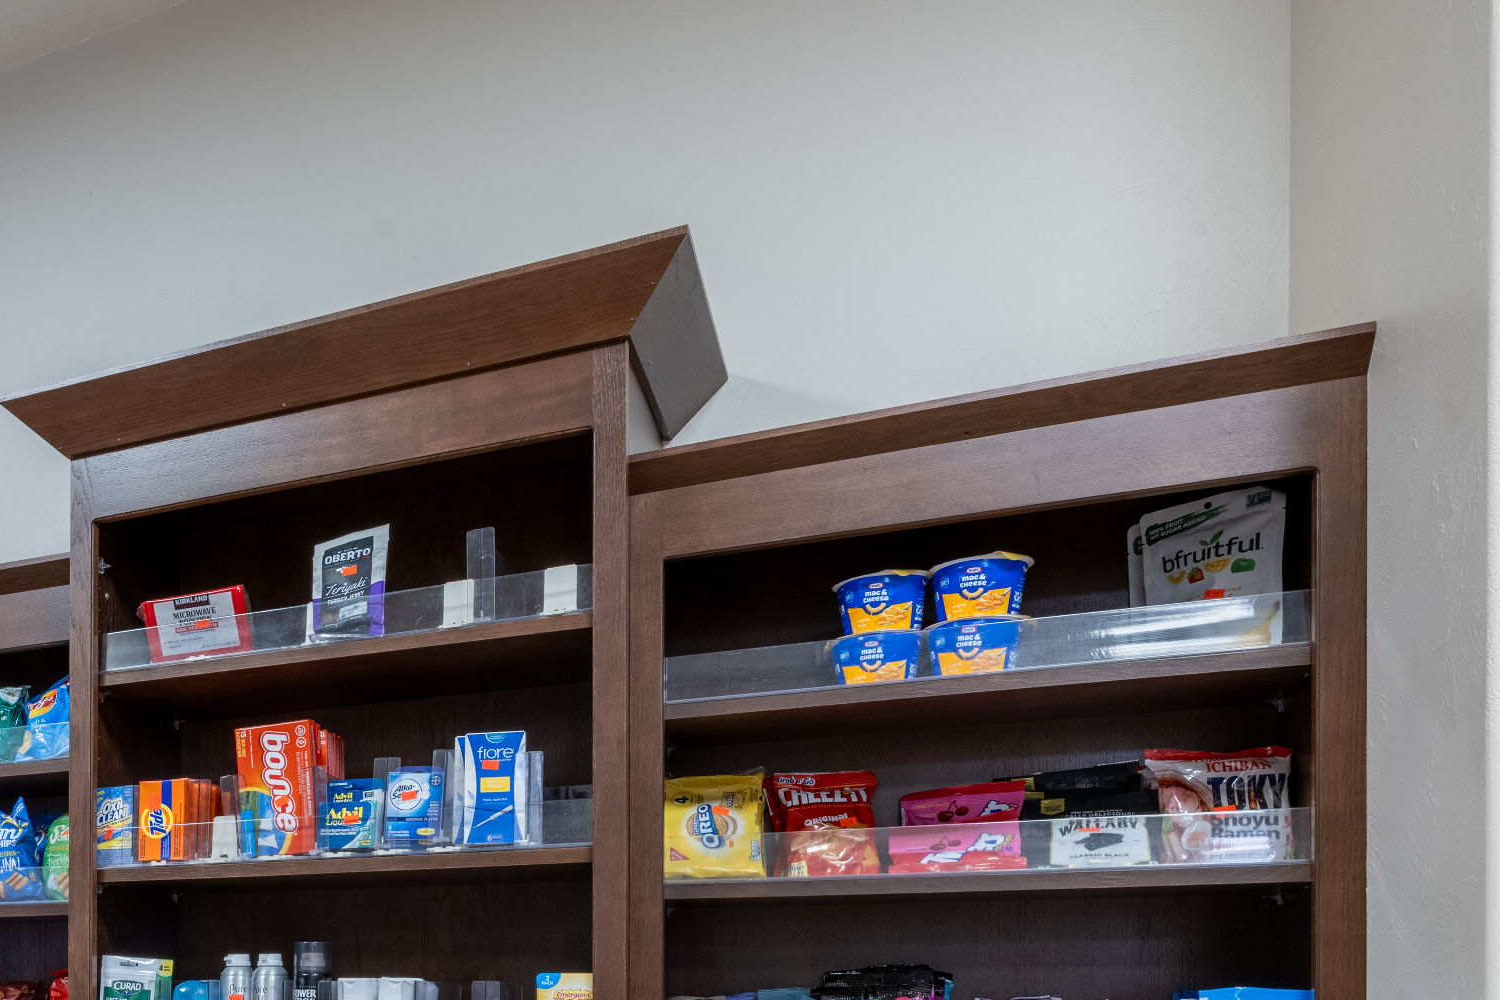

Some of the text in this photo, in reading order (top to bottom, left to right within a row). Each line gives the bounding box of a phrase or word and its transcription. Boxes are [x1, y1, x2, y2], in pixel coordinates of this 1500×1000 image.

[1161, 525, 1182, 537] SUGAR
[1166, 519, 1184, 530] FRUIT
[325, 548, 371, 564] OBERTO
[1162, 532, 1262, 574] bfruitful
[326, 577, 368, 596] Teriyaki
[960, 580, 987, 588] cheese
[174, 594, 208, 606] KIRKLAND
[173, 607, 216, 620] MICROWAVE
[956, 640, 982, 648] cheese
[958, 634, 973, 642] mac
[477, 746, 514, 760] fiore
[1207, 760, 1272, 773] ICHIBAN
[261, 731, 298, 833] bounce
[777, 777, 815, 786] Grab Go
[333, 792, 353, 800] Advil
[675, 794, 690, 804] 4
[103, 800, 122, 814] OXI
[327, 807, 363, 820] Advil
[97, 807, 128, 826] CLEAN
[149, 808, 167, 836] Tide
[696, 804, 723, 848] OREO
[113, 981, 142, 990] CURAD
